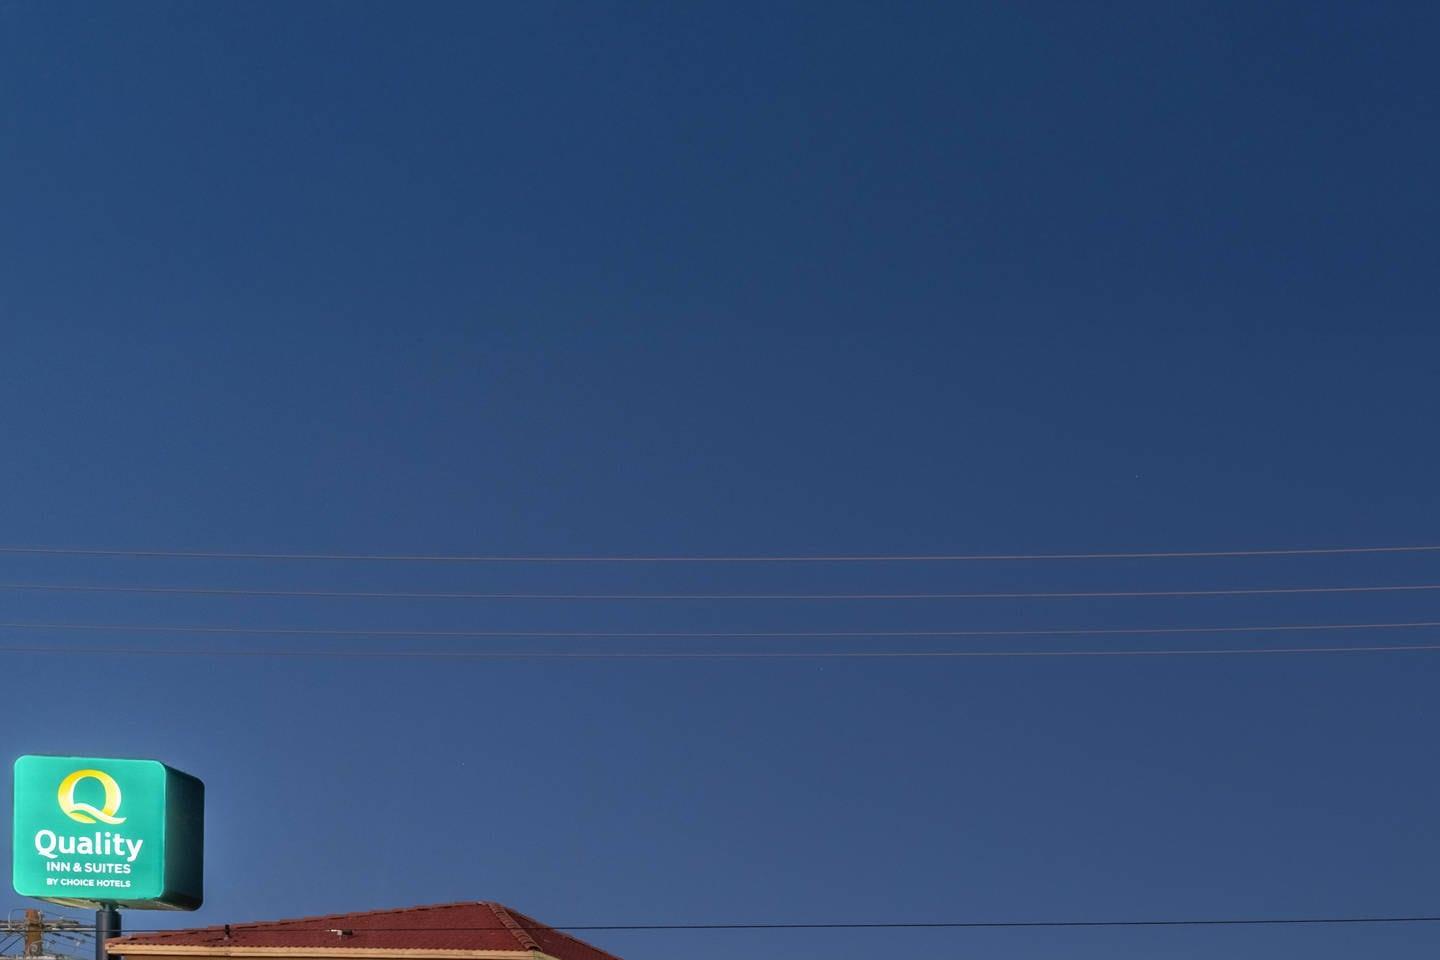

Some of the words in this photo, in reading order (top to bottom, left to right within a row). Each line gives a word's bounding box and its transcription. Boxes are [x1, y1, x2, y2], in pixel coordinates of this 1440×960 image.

[58, 769, 127, 824] Q
[34, 829, 143, 862] Quality
[46, 861, 71, 873] INN
[73, 862, 82, 873] &
[85, 862, 131, 874] SUITES
[46, 877, 59, 886] BY
[60, 878, 95, 887] CHOICE
[96, 879, 131, 888] HOTELS
